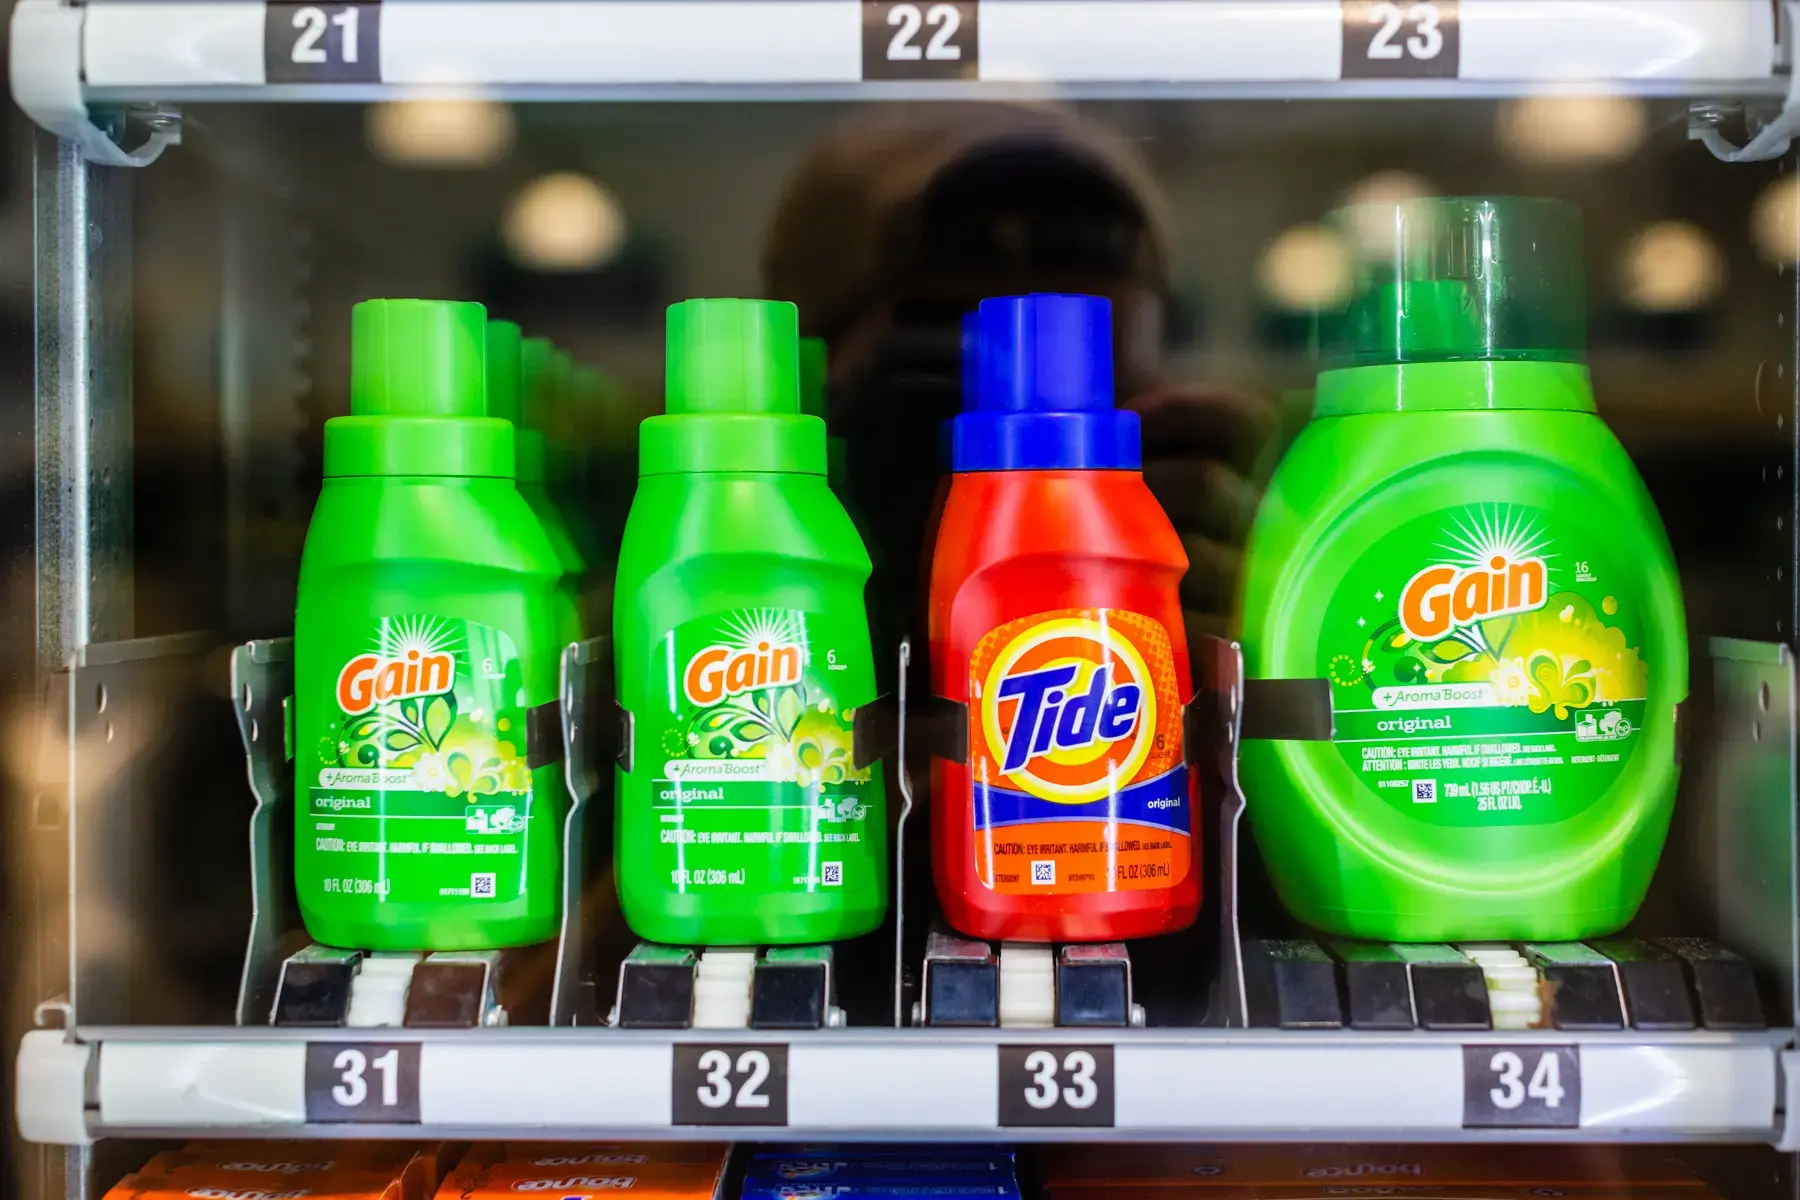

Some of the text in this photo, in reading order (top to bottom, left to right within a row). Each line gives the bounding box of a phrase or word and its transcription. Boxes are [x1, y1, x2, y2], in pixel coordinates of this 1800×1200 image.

[291, 6, 359, 63] 21
[886, 3, 962, 60] 22
[1366, 2, 1443, 60] 23
[1575, 561, 1589, 573] 16
[1402, 555, 1544, 638] Gain
[482, 657, 492, 673] 6
[827, 649, 836, 664] 6
[338, 649, 452, 713] Gain
[686, 640, 800, 705] Gain
[998, 661, 1140, 775] Tide
[1377, 715, 1452, 733] original
[1156, 733, 1165, 750] 6
[1361, 746, 1396, 759] CAUTION:
[1397, 747, 1411, 758] EYE
[1362, 759, 1403, 771] ATTENTION
[660, 787, 725, 803] original
[1444, 783, 1458, 797] 739
[1459, 783, 1471, 796] mL
[1490, 782, 1500, 796] US
[315, 796, 371, 811] original
[1148, 796, 1181, 810] original
[1477, 797, 1487, 811] 25
[1497, 797, 1507, 810] OZ
[994, 842, 1025, 855] CAUTION:
[1027, 844, 1039, 855] EYE
[1070, 843, 1098, 854] HARMFUL
[1099, 842, 1105, 853] IF
[694, 870, 706, 884] OZ
[707, 868, 727, 885] (306
[728, 868, 745, 885] mL)
[1118, 865, 1127, 879] FL
[1128, 865, 1139, 879] OZ
[1140, 863, 1156, 879] (306
[1157, 861, 1170, 877] mL)
[333, 878, 341, 892] FL
[342, 878, 353, 893] OZ
[331, 1048, 399, 1106] 31
[697, 1049, 771, 1108] 32
[1023, 1050, 1098, 1109] 33
[1489, 1050, 1565, 1109] 34
[1306, 1162, 1422, 1178] bounce
[517, 1175, 634, 1191] bounce
